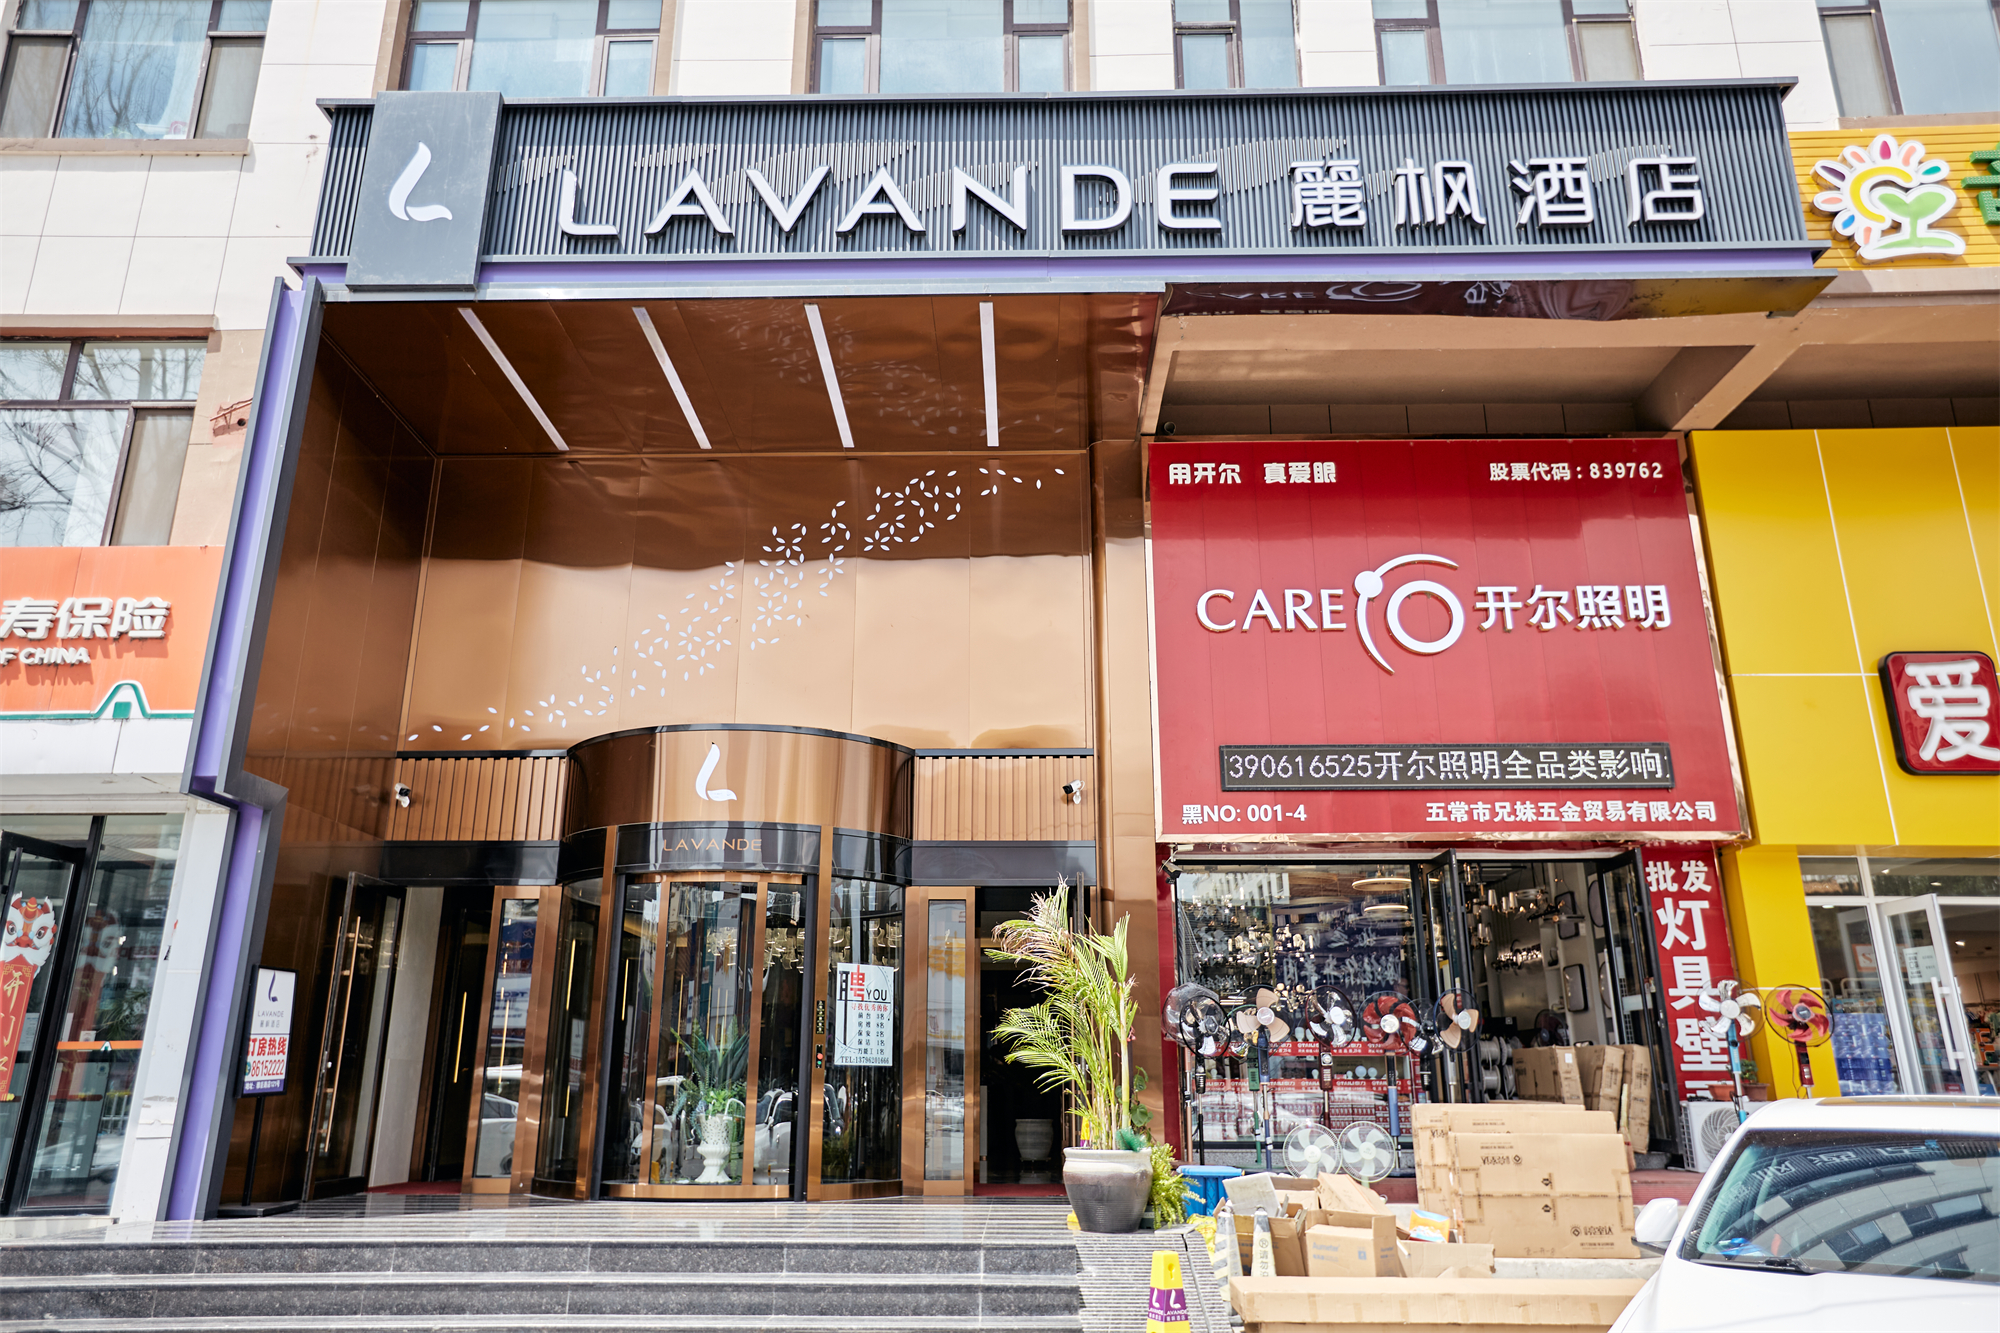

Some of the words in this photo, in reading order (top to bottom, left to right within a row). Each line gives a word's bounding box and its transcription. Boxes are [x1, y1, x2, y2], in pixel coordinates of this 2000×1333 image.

[557, 162, 1222, 239] LAVANDE
[1289, 155, 1706, 232] 麗枫酒店
[1168, 463, 1242, 485] 用开尔
[1263, 461, 1337, 484] 真爱眼
[0, 597, 171, 640] 寿保险
[1196, 588, 1348, 632] CARE
[1474, 583, 1672, 632] 开尔照明
[19, 647, 91, 666] CHINA
[1904, 659, 2000, 762] 爱
[1228, 748, 1670, 781] 390616525开尔照明全品类影响
[1246, 804, 1308, 822] 001-4
[1425, 800, 1717, 822] 五常市兄妹五金贸易有限公司
[663, 838, 763, 851] LAVANDE
[1645, 860, 1712, 893] 批发
[866, 988, 888, 1001] YOU
[257, 1010, 285, 1018] LAVANDE
[250, 1059, 285, 1077] 86152222
